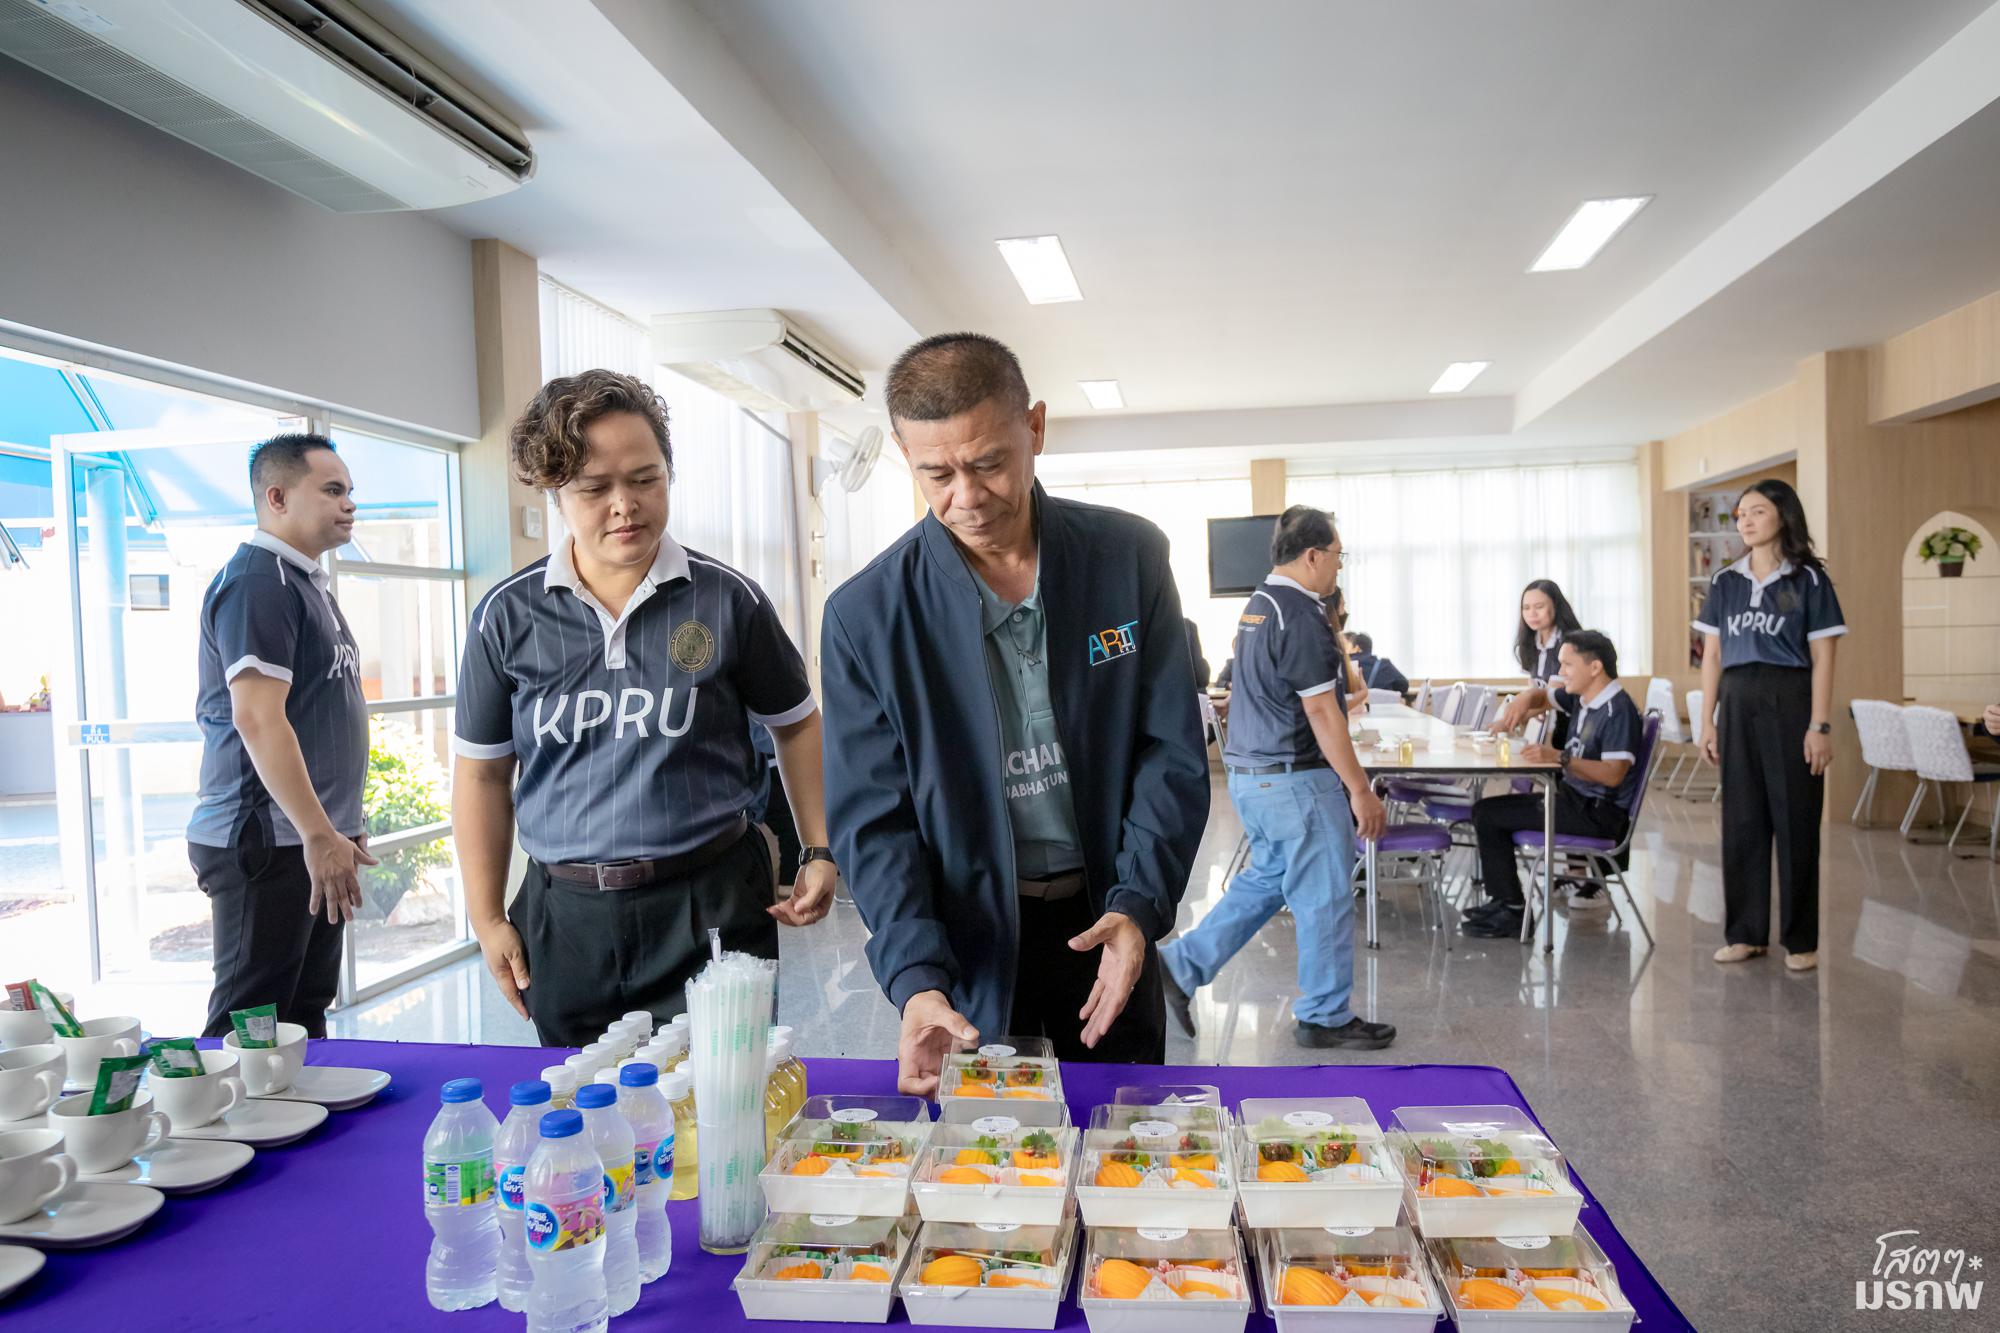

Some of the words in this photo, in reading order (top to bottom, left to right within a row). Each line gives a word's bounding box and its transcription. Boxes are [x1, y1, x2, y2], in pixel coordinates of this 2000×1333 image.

[1727, 611, 1785, 637] KPRU
[533, 687, 698, 747] KPRU
[1005, 742, 1064, 778] CHA
